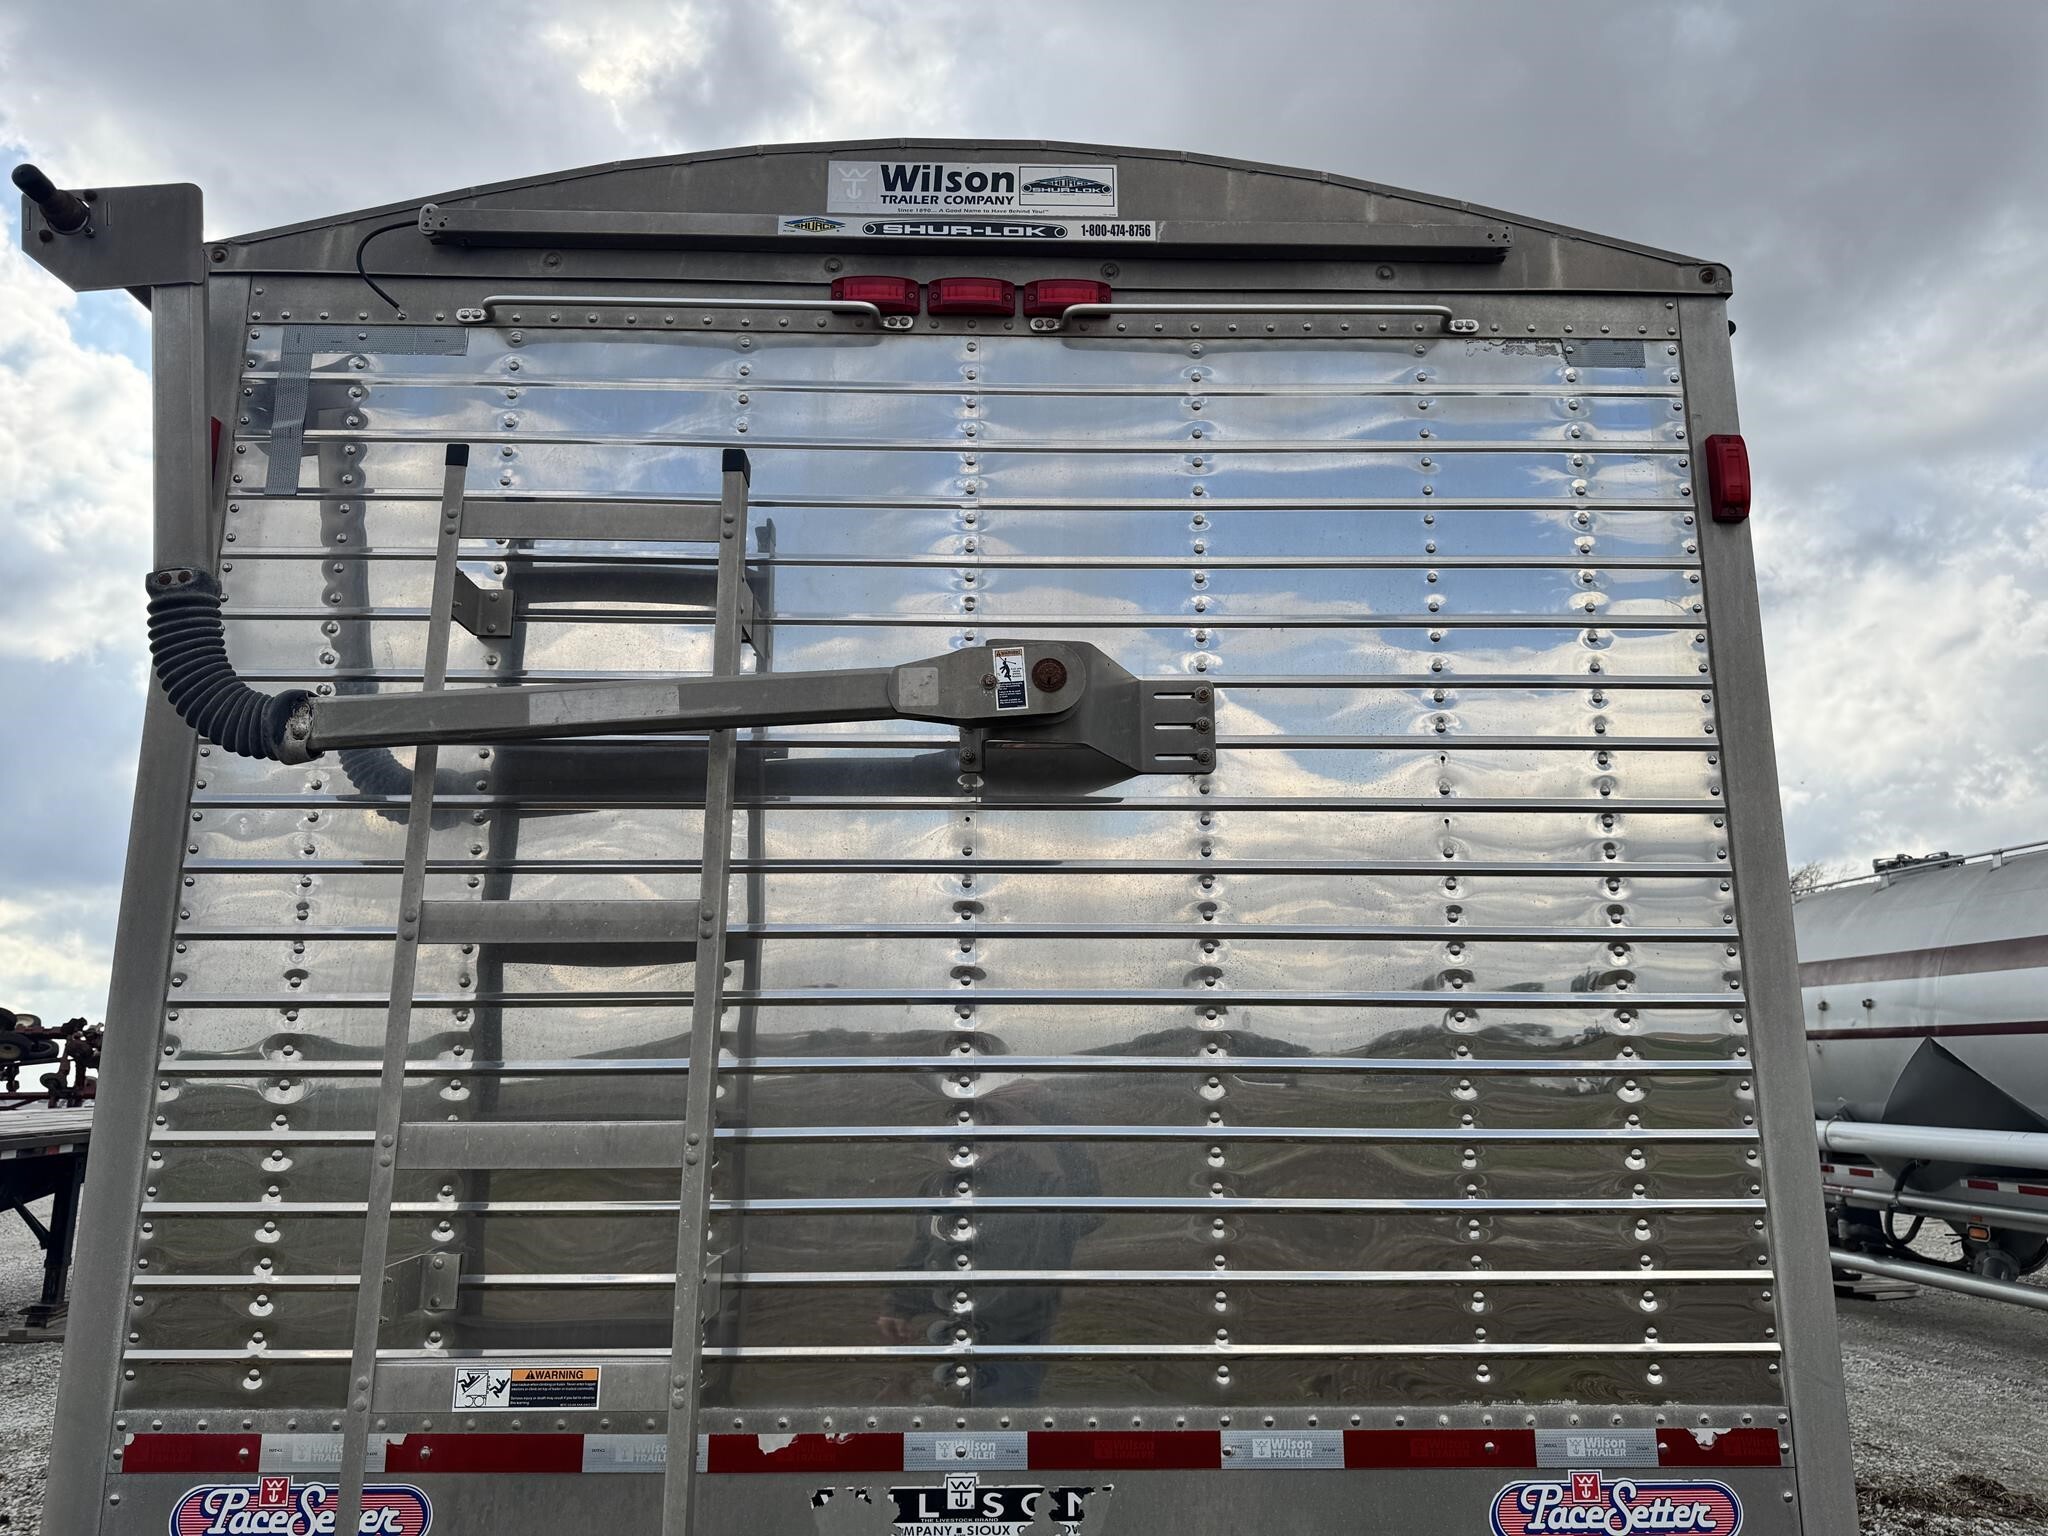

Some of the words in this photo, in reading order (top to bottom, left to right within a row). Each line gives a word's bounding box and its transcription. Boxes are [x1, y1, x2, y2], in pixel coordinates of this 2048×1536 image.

[880, 164, 1015, 193] Wilson
[880, 195, 939, 205] TRAILER
[943, 195, 1015, 206] COMPANY
[882, 224, 1047, 237] SHUR-LOK
[1081, 224, 1151, 237] 1-800-474-8756
[535, 1370, 584, 1380] WARNING
[1271, 1439, 1313, 1450] Wilson
[1585, 1437, 1626, 1448] Wilson
[1272, 1450, 1313, 1458] TRAILER
[1586, 1448, 1626, 1457] TRAILER
[204, 1485, 404, 1536] PaceSeer
[1520, 1481, 1717, 1536] PaceSetter
[903, 1525, 953, 1536] MPANY
[967, 1524, 1011, 1536] SIOUX
